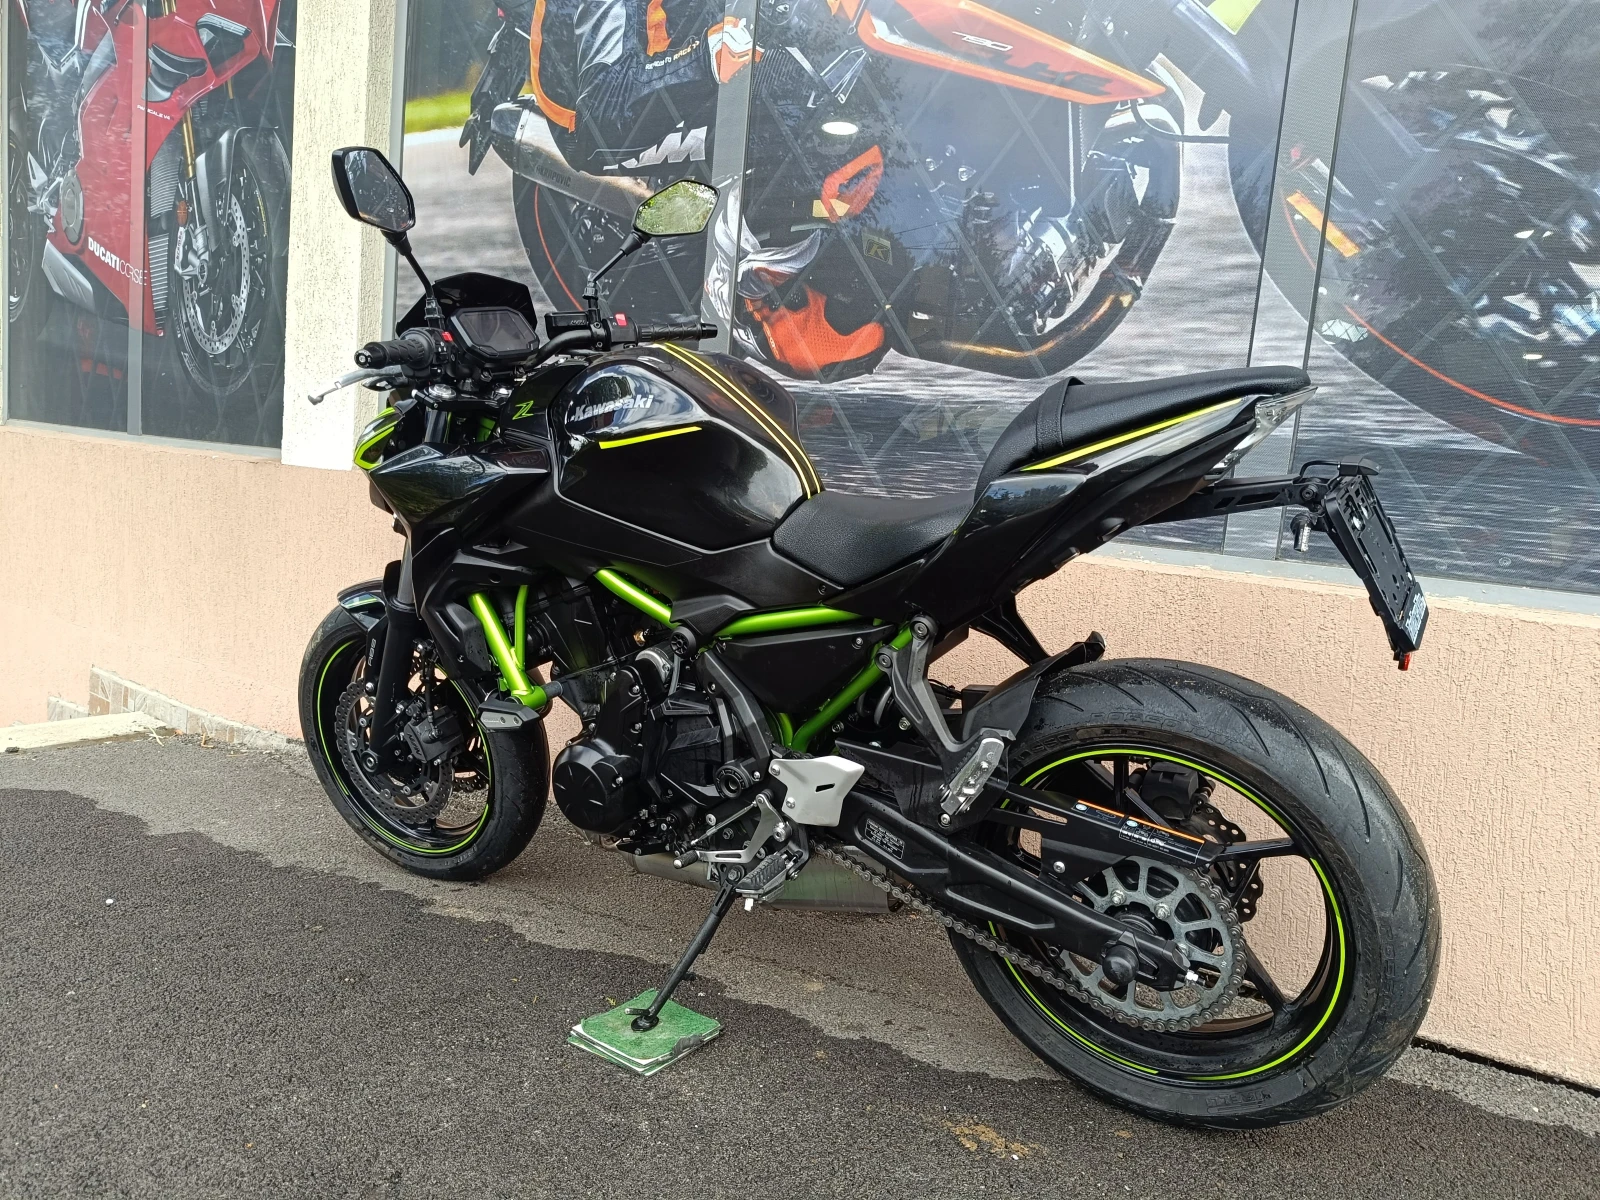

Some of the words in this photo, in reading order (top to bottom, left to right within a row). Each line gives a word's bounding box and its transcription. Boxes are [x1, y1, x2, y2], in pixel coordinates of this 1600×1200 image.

[88, 236, 120, 272] DUCATI
[511, 400, 534, 421] Z
[573, 394, 655, 422] Kawasaki
[367, 638, 377, 667] ABS
